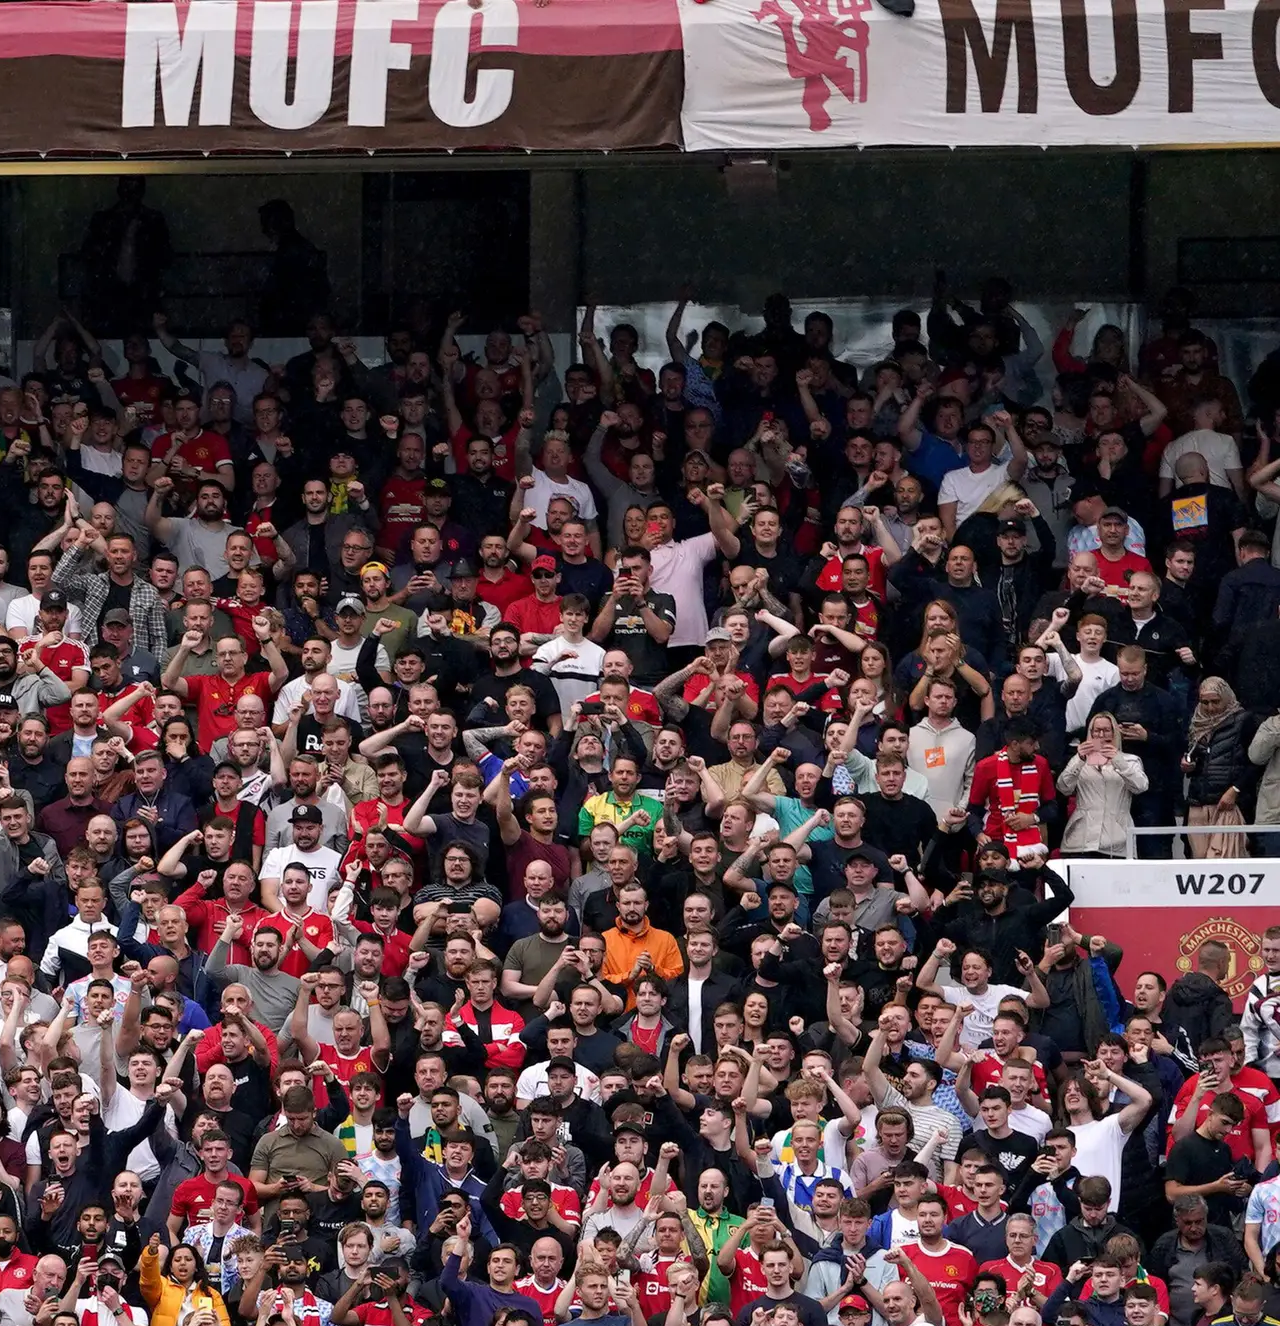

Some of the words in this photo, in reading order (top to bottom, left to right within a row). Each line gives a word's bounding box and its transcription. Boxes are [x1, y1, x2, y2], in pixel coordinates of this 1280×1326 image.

[121, 0, 519, 129] MUFC
[621, 830, 644, 839] ARP
[308, 870, 326, 880] NS
[1176, 873, 1266, 895] W207
[1182, 921, 1261, 953] MANCHESTER
[319, 1220, 344, 1229] GIVENC
